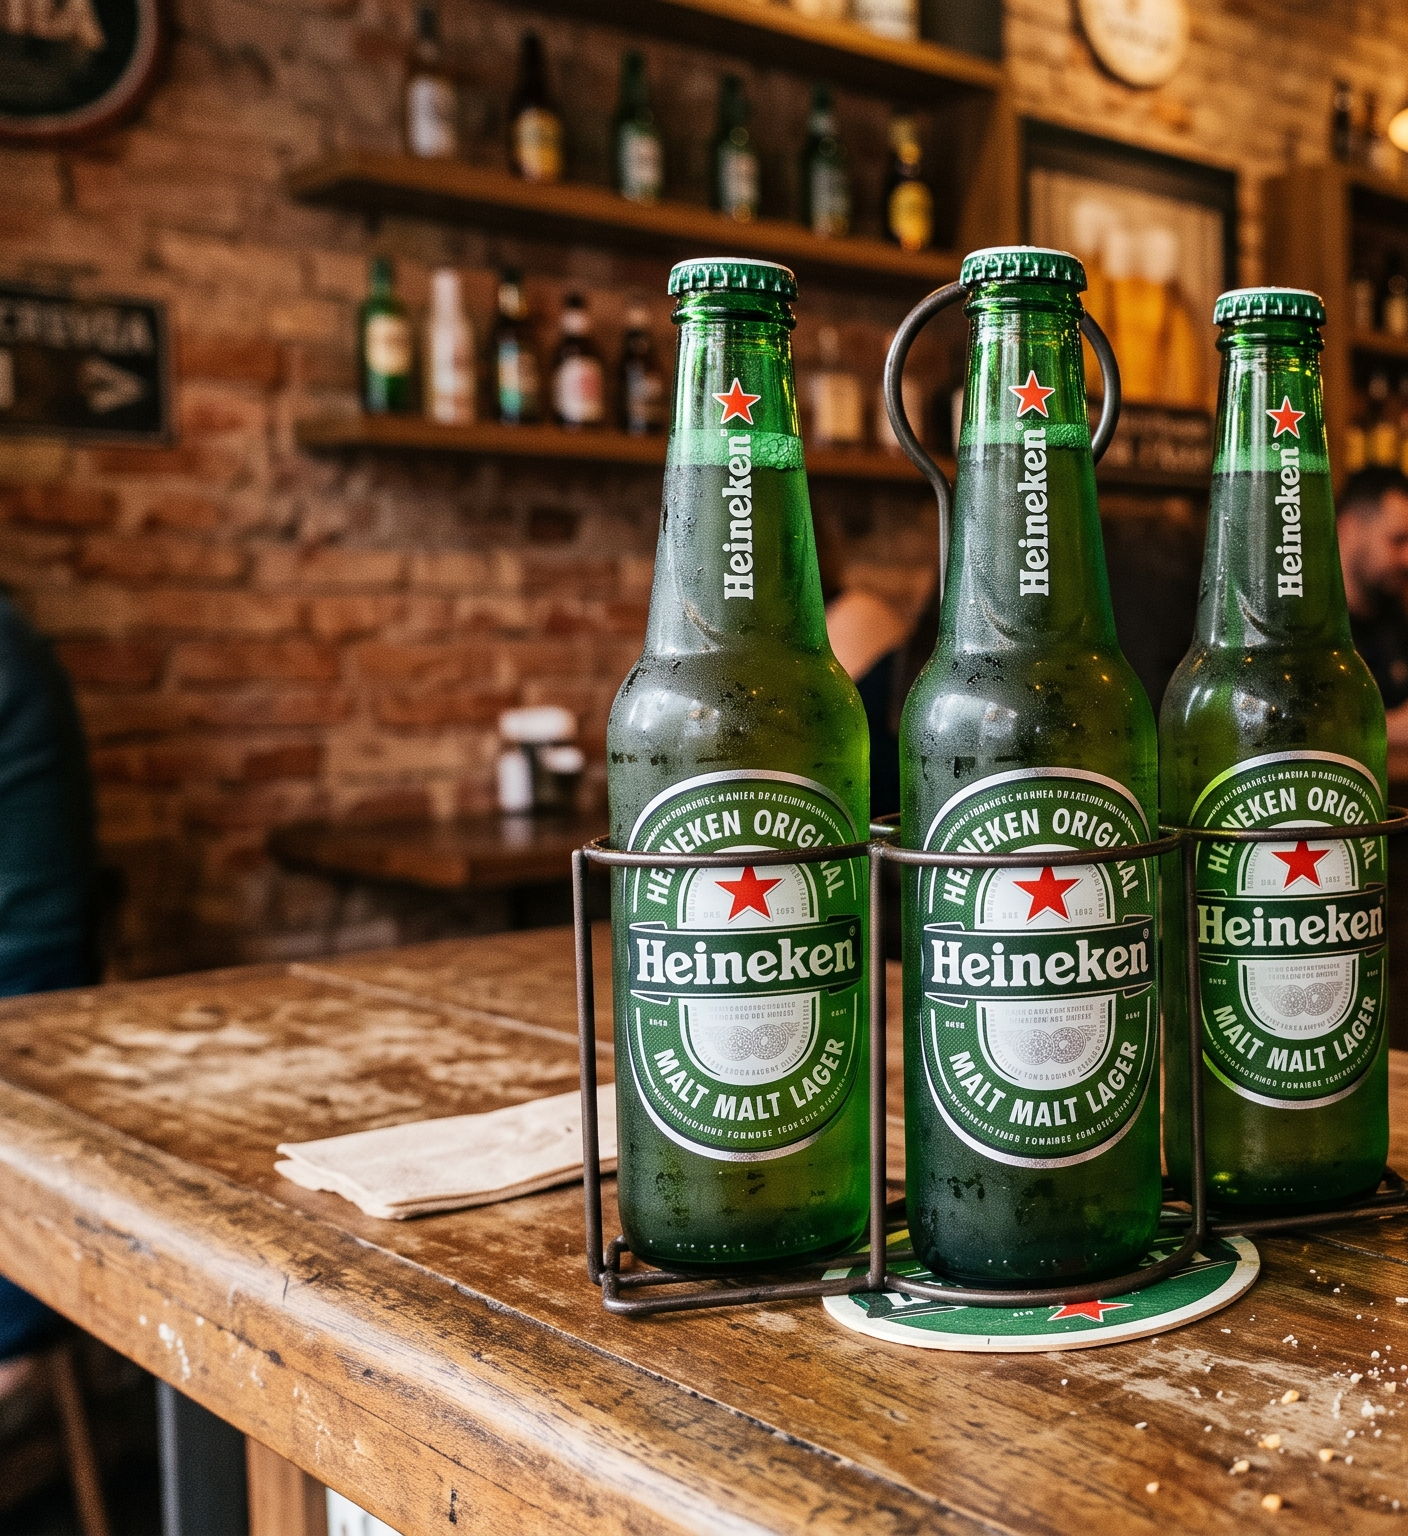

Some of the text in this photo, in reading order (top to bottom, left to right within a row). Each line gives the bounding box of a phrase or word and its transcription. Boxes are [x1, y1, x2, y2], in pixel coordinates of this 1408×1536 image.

[722, 434, 753, 600] Heineken
[1017, 427, 1049, 596] Heineken
[1275, 447, 1303, 598] Heineken
[636, 938, 855, 985] Heineken
[931, 939, 1149, 987] Heineken
[1197, 904, 1384, 947] Heineken
[1213, 1004, 1265, 1061] MALT
[1266, 1046, 1326, 1073] MALT
[1333, 995, 1376, 1061] LAGER
[654, 1048, 710, 1109] MALT
[712, 1091, 781, 1121] MALT
[789, 1038, 845, 1109] LAGER
[950, 1050, 1007, 1113] MALT
[1008, 1097, 1078, 1127] MALT
[1085, 1041, 1138, 1114] LAGER
